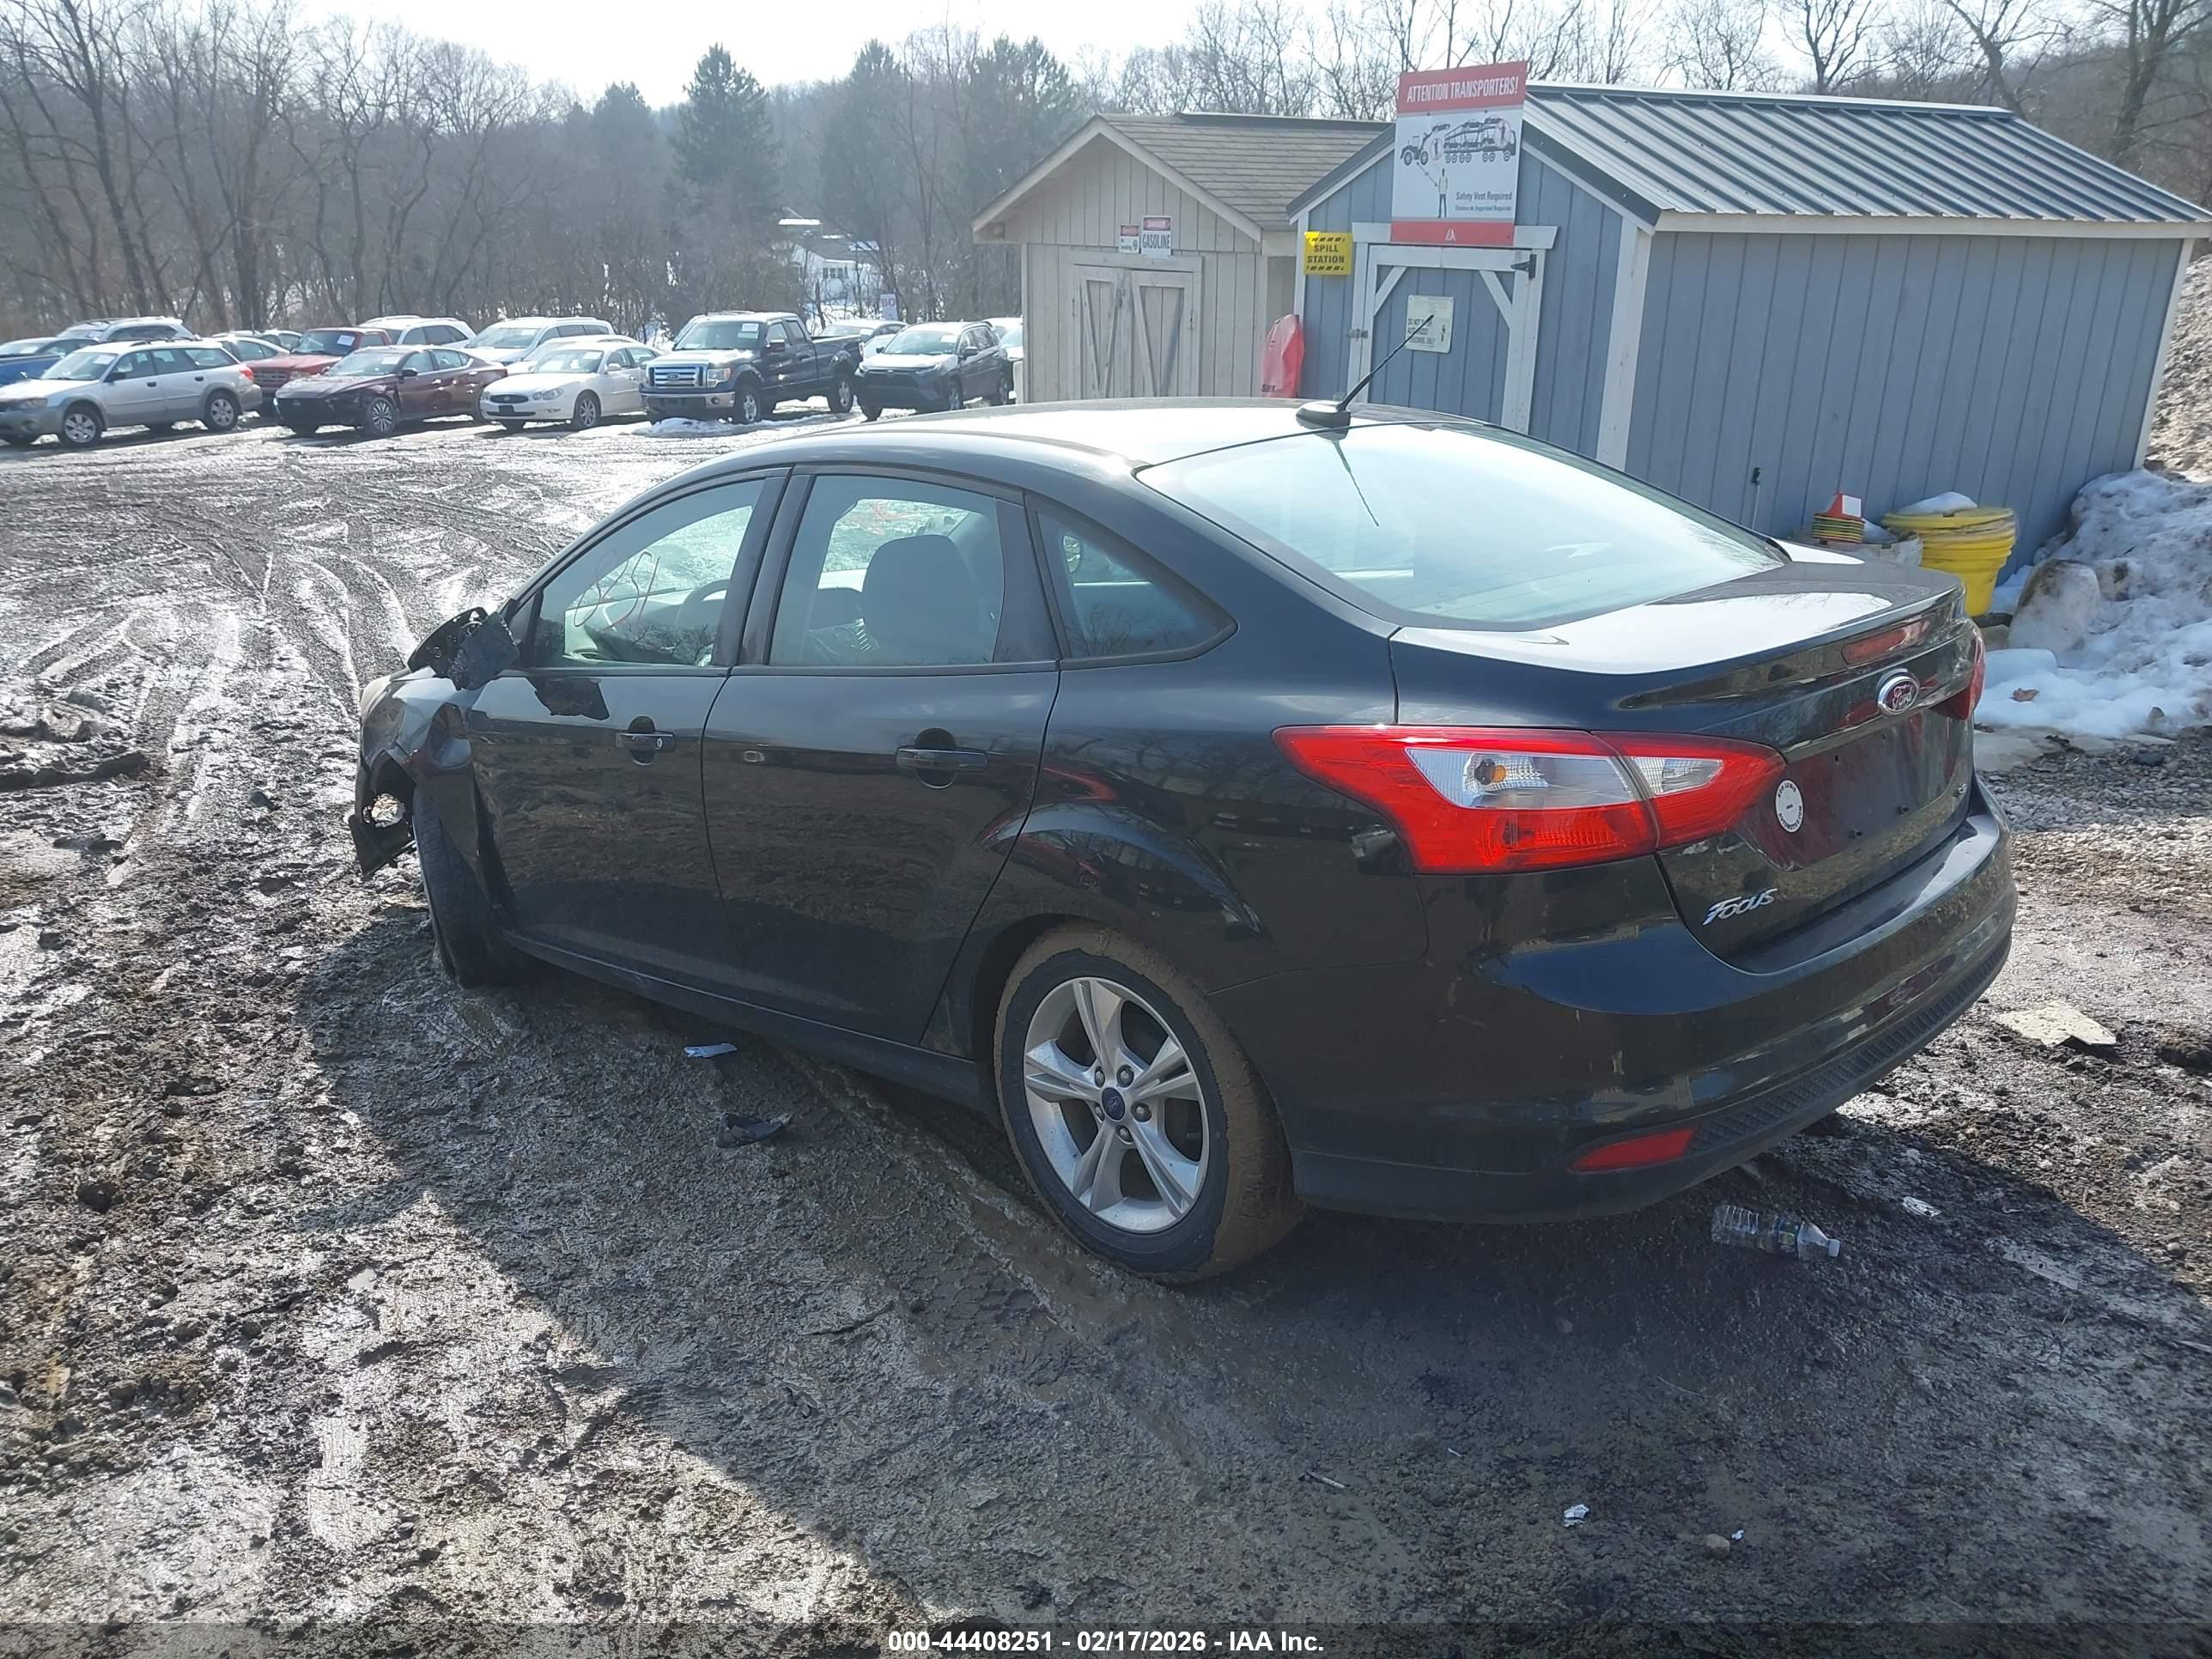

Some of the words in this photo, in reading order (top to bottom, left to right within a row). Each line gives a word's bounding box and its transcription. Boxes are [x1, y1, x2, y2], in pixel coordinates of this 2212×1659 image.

[1407, 83, 1448, 102] ATTENTION
[1450, 76, 1519, 99] TRANSPORTERS!
[1455, 191, 1473, 202] Safety
[1474, 191, 1486, 200] Vest
[1486, 191, 1512, 202] Required
[1142, 233, 1170, 249] GASOLINE
[1314, 244, 1340, 252] SPILL
[1307, 255, 1345, 264] STATION
[1892, 684, 1911, 710] Ford
